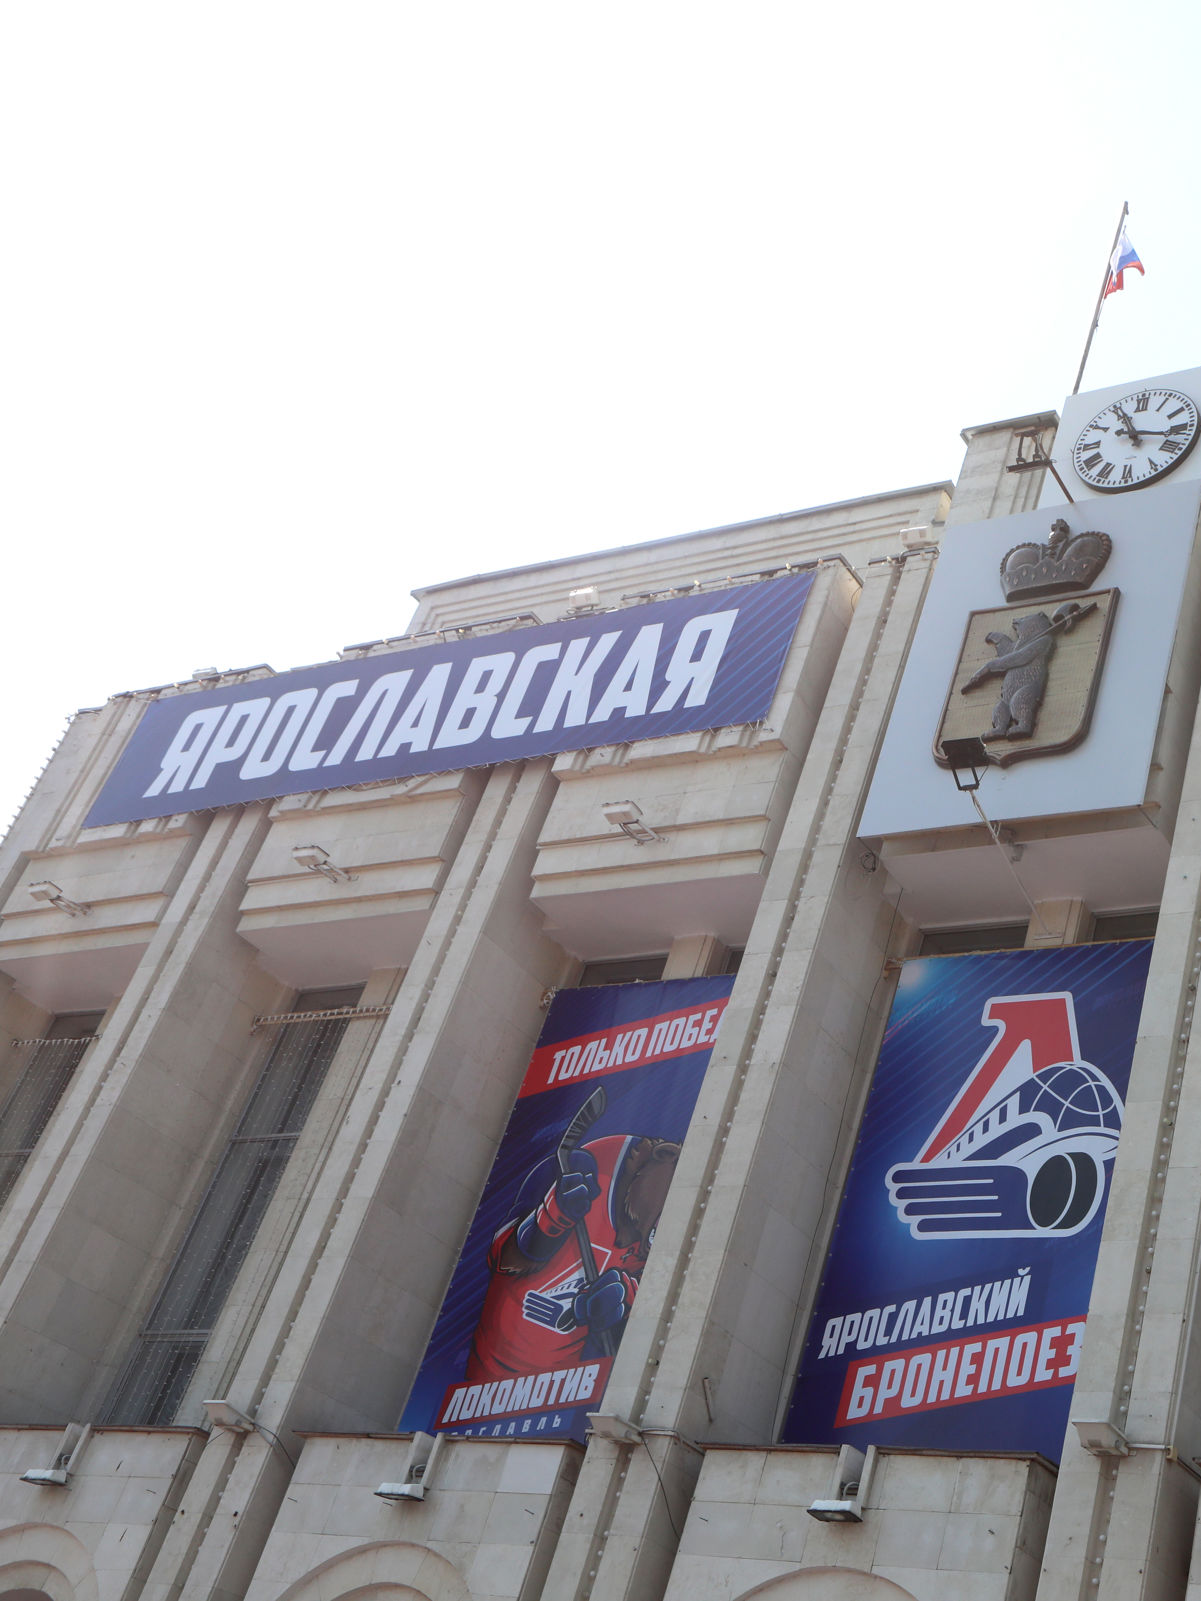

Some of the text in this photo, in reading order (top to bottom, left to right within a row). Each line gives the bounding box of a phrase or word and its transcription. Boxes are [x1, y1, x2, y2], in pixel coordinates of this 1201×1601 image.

[1134, 397, 1149, 412] XII
[143, 609, 739, 797] ЯРОСЛАВСКАЯ
[547, 1027, 648, 1084] ТОЛЬКО
[818, 1267, 1031, 1358] ЯРОСЛАВСКИЙ
[441, 1363, 600, 1424] ЛОКОМОТИВ
[847, 1321, 1086, 1420] БРОНЕПОЕЗ
